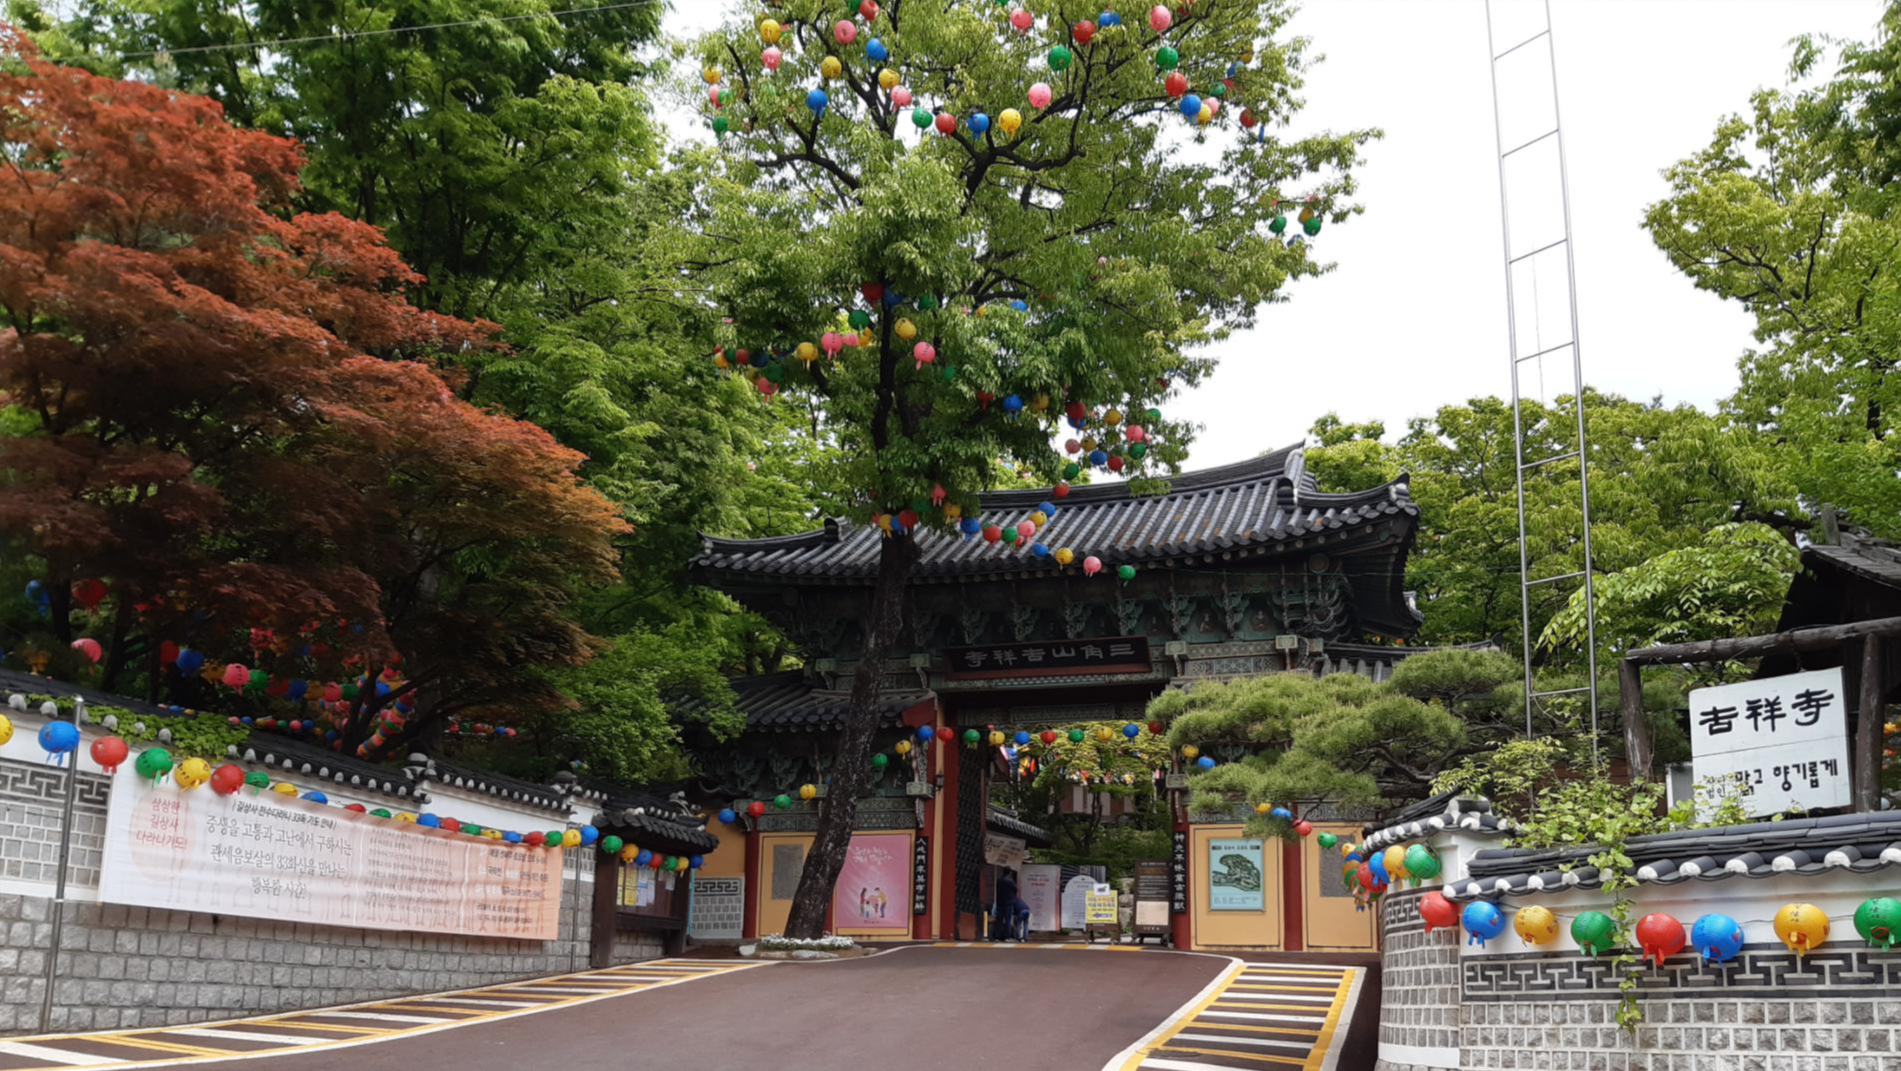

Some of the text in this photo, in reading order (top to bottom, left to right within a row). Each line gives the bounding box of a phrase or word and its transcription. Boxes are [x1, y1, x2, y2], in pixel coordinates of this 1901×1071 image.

[1698, 688, 1835, 736] 吉祥寺
[1773, 759, 1839, 792] 향기롭게
[150, 814, 179, 832] 길상사
[206, 815, 240, 837] 중생을
[242, 822, 273, 842] 고통과
[275, 828, 314, 849] 고난에서
[316, 835, 353, 856] 구하시는
[210, 843, 274, 869] 관세음보살의
[318, 861, 346, 879] 만나는
[252, 877, 283, 897] 행복한
